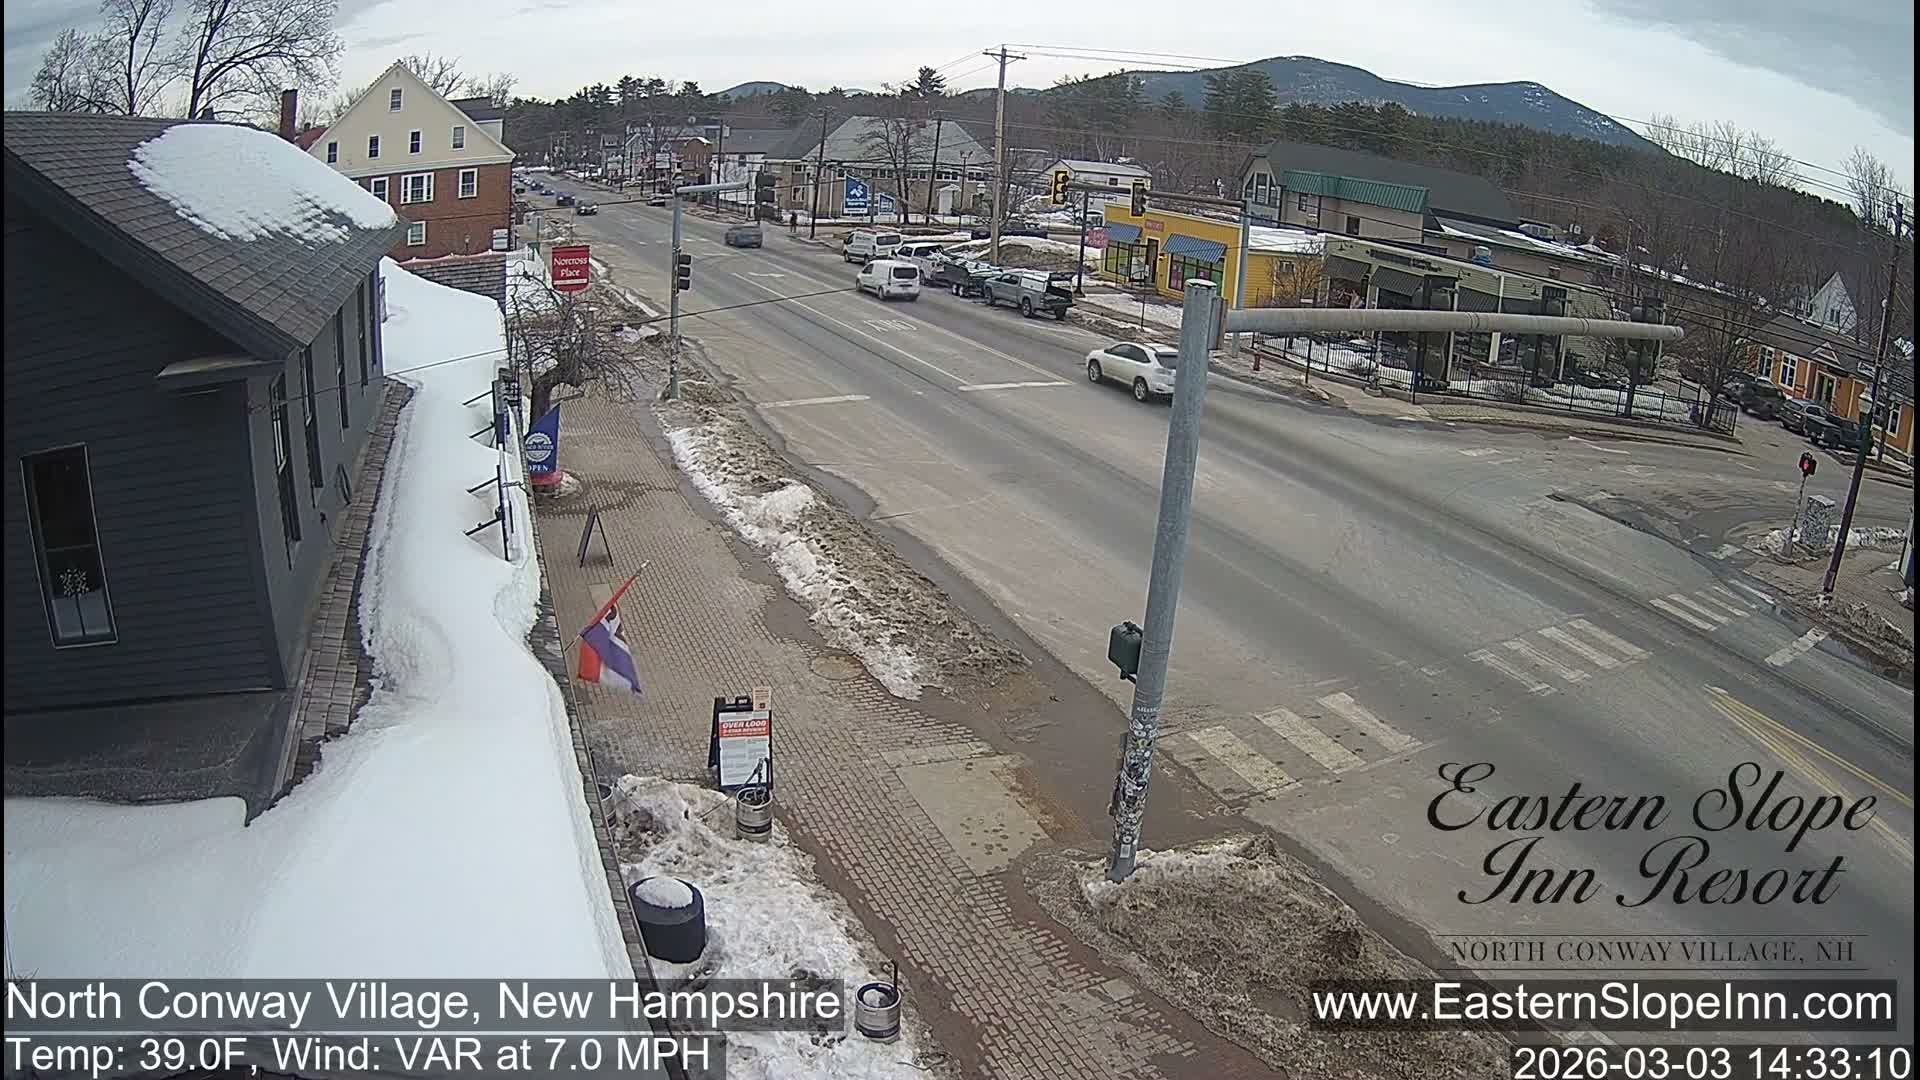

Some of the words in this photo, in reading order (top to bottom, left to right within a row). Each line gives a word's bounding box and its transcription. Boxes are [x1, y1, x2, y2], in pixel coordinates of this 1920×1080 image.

[553, 257, 588, 266] Norcross
[560, 268, 581, 277] Place
[722, 721, 745, 729] OVER
